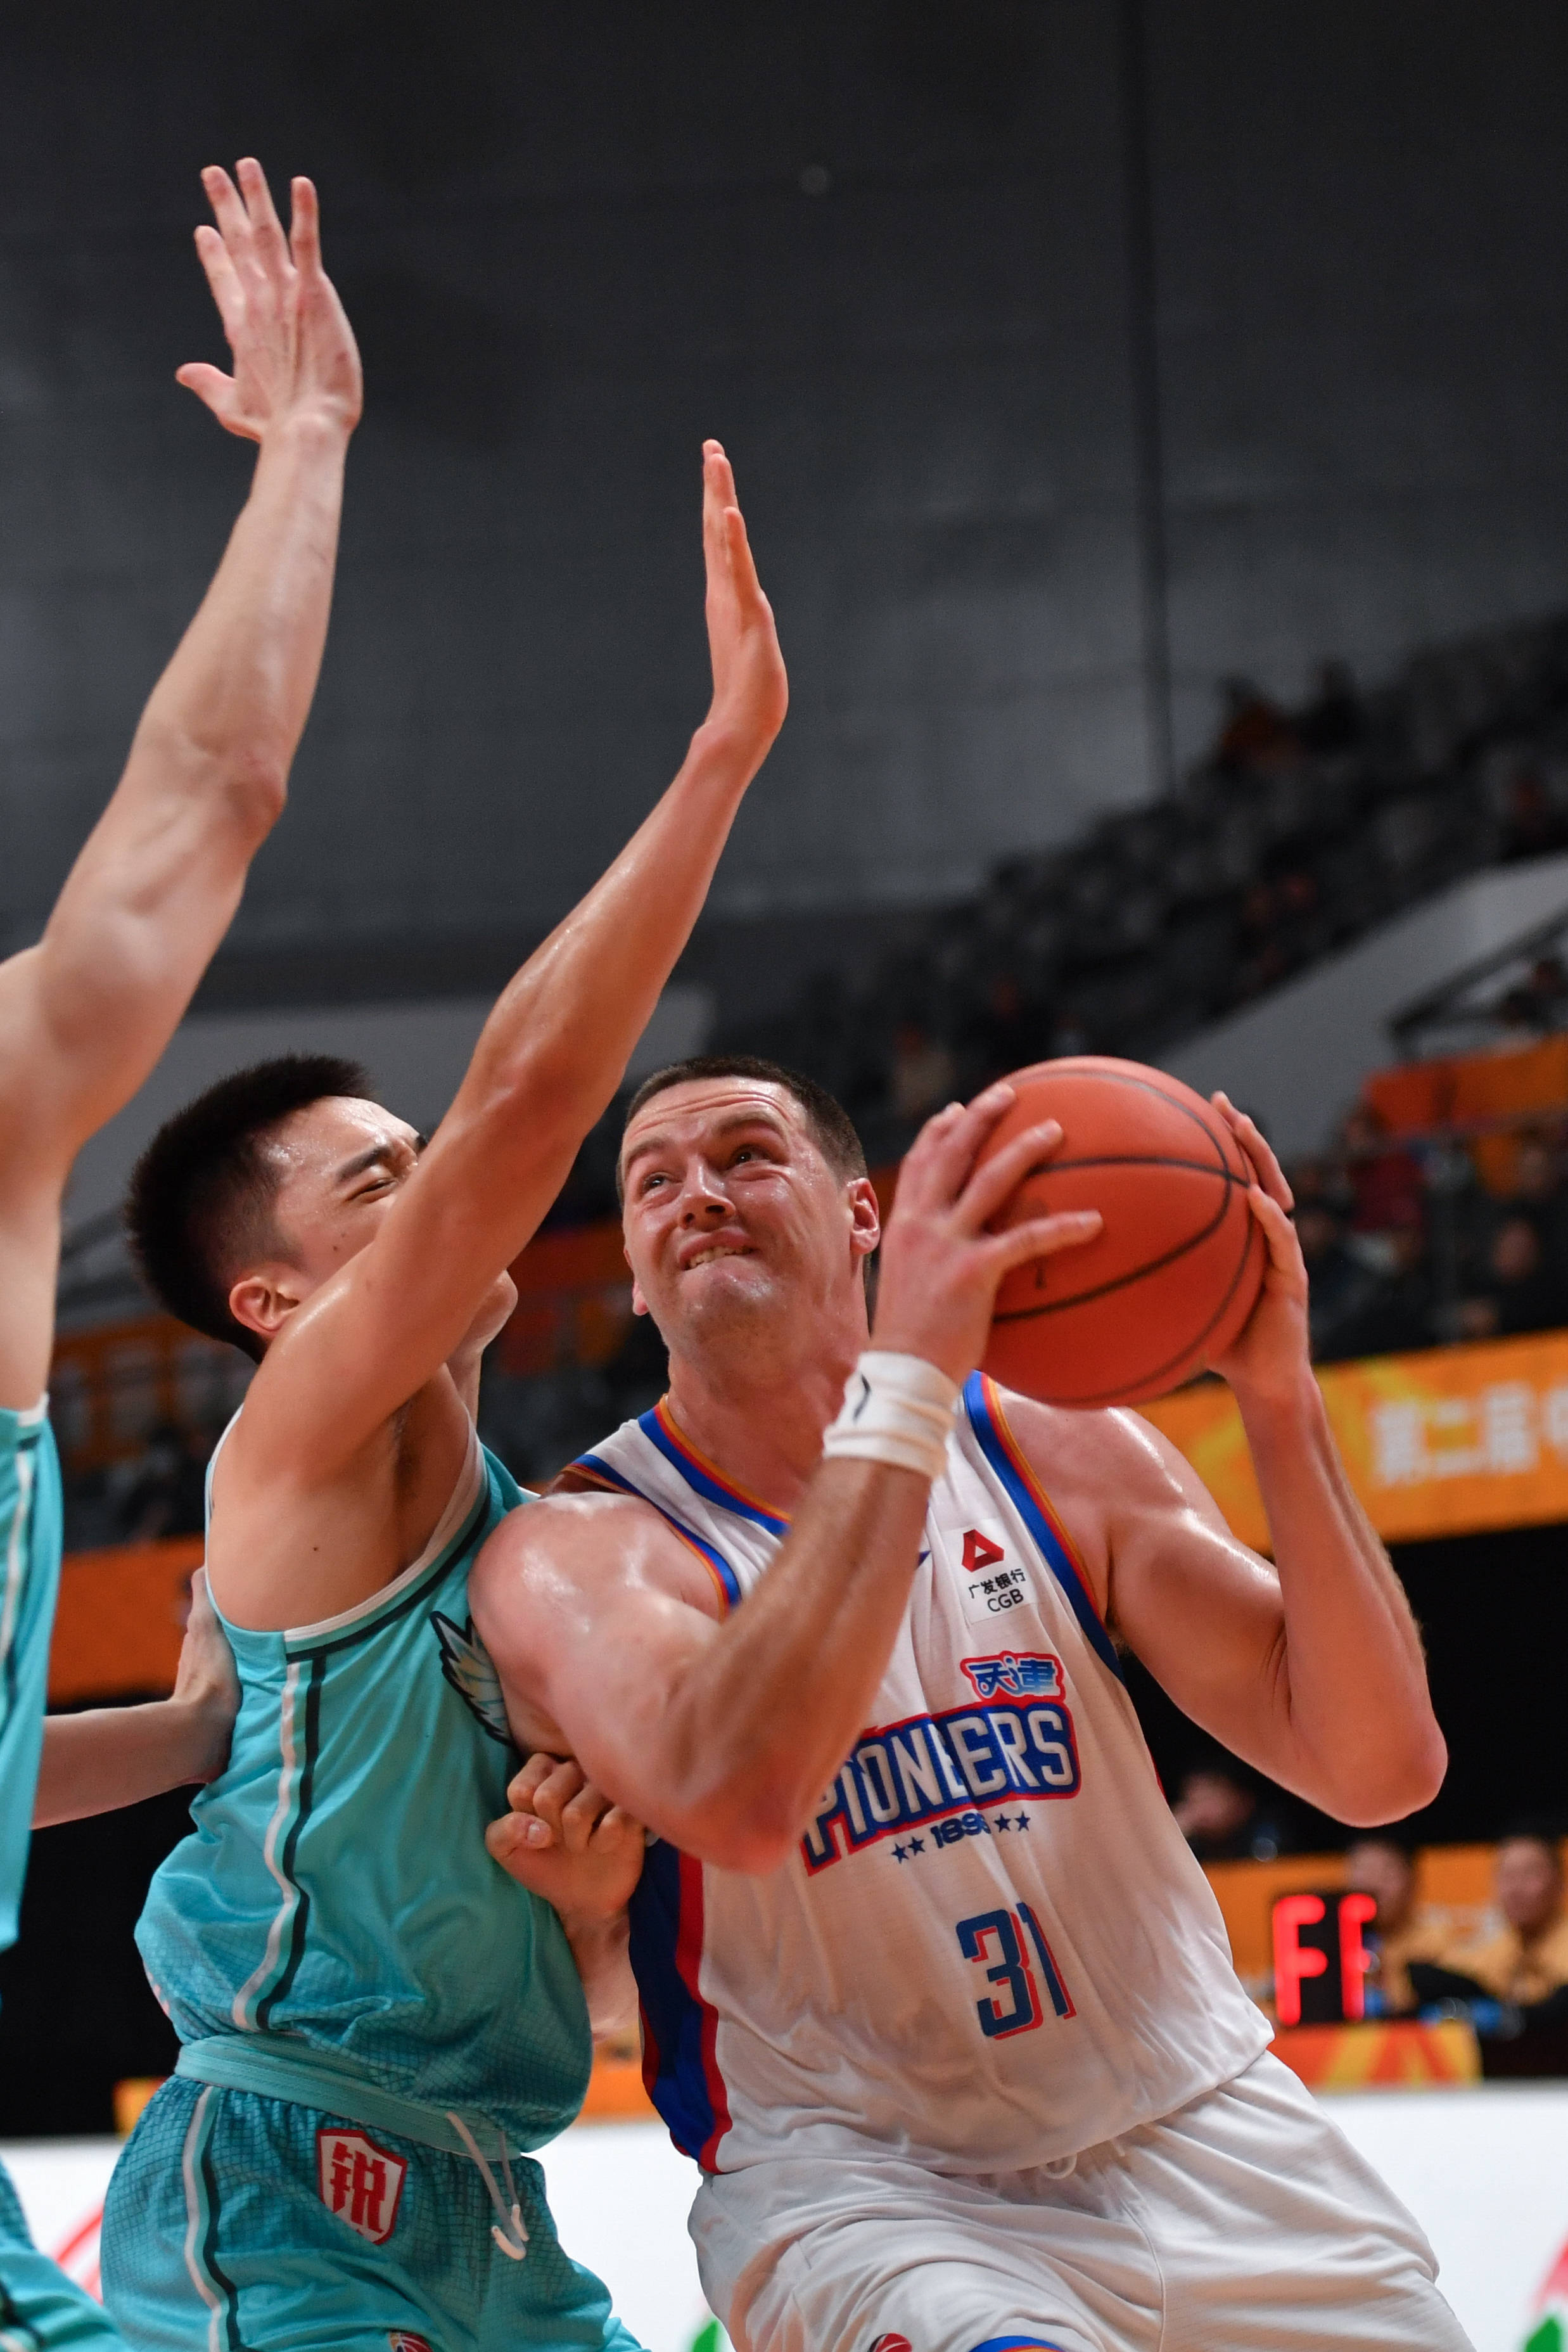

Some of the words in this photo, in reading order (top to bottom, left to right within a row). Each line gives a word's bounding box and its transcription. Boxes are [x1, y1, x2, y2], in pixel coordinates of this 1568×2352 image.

[968, 1568, 1026, 1599] 广发银行
[987, 1588, 1024, 1613] CGB
[966, 1656, 1061, 1698] 天津
[955, 1901, 1077, 2040] 31
